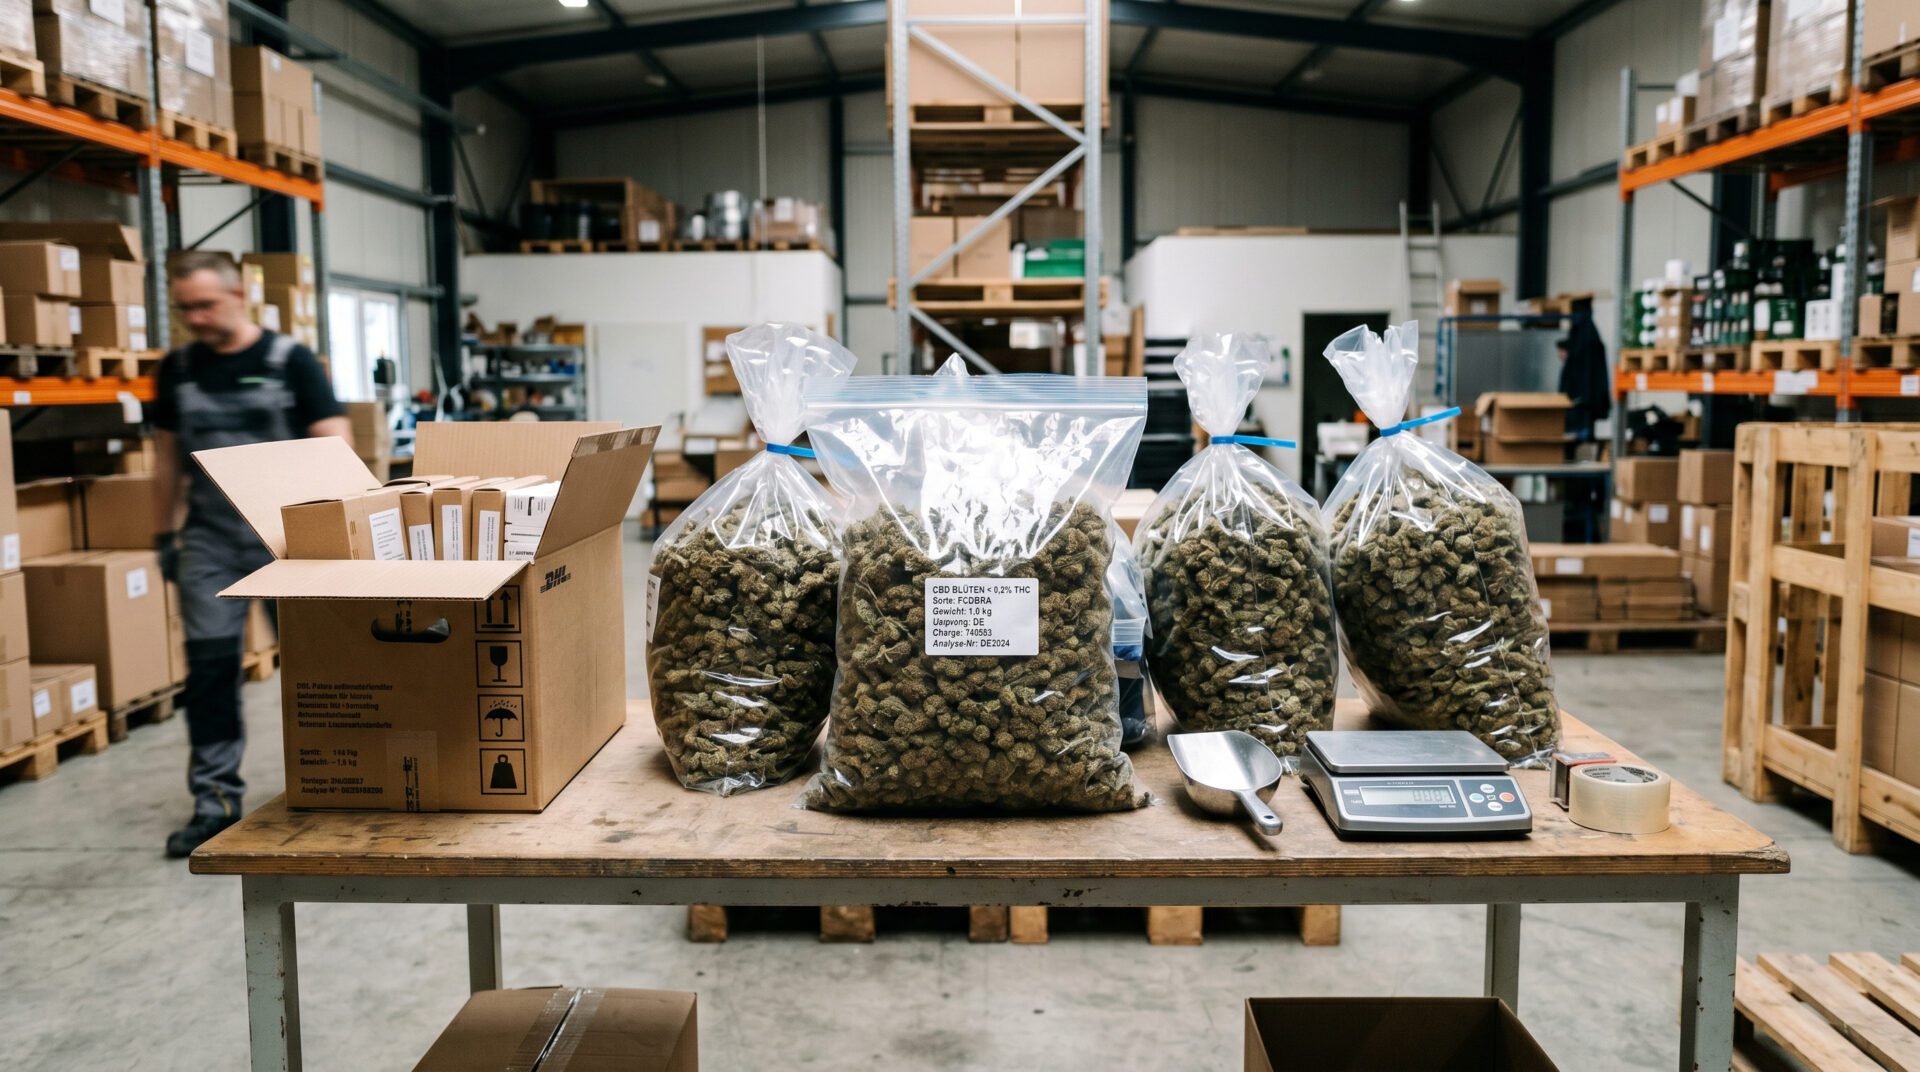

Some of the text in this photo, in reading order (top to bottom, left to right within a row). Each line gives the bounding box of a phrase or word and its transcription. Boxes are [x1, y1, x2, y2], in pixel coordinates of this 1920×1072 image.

[932, 585, 950, 594] CBD
[952, 584, 985, 594] BLÜTEN
[993, 585, 1012, 595] 0,2%
[1014, 585, 1031, 594] THC
[932, 596, 992, 605] Sorte: FCDBRA
[932, 607, 967, 616] Gewicht:
[982, 607, 993, 617] kg
[973, 618, 985, 626] DE
[932, 628, 963, 638] Charge:
[932, 639, 1010, 650] Analyse-Nr: DE2024
